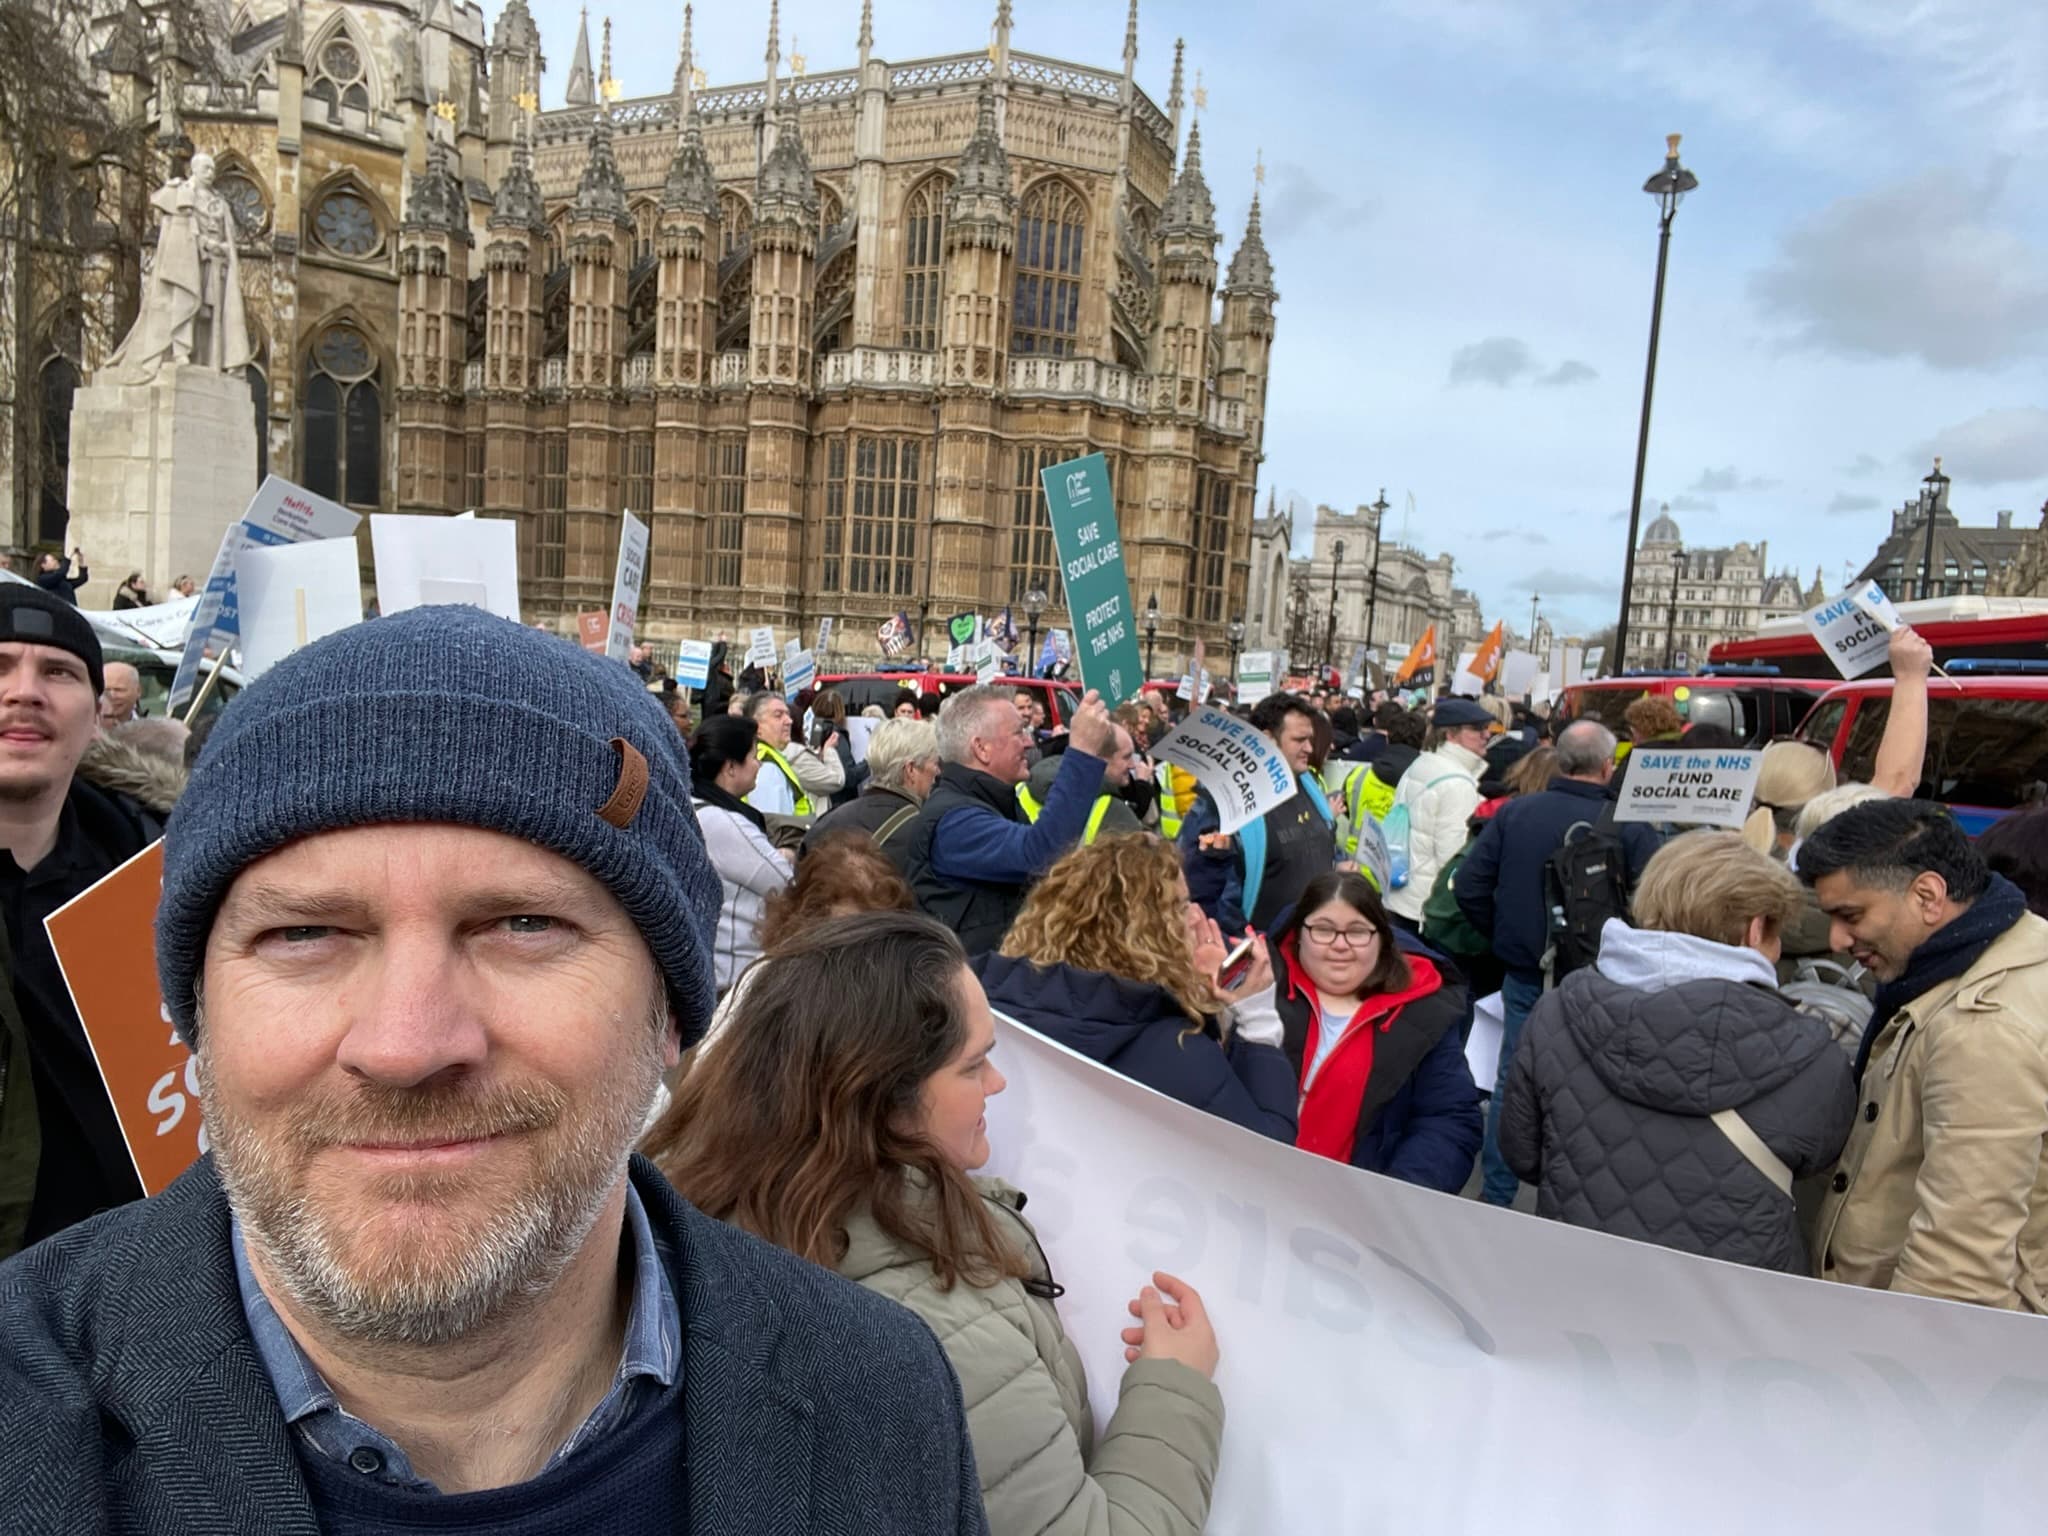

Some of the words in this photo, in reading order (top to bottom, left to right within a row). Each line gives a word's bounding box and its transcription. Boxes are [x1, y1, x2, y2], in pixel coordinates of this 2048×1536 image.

[1077, 521, 1100, 547] SAVE
[1067, 551, 1099, 582] SOCIAL
[1097, 541, 1119, 566] CARE
[1085, 595, 1121, 632] PROTECT
[1814, 597, 1855, 627] SAVE
[1090, 632, 1109, 657] THE
[1106, 621, 1125, 647] NHS
[1200, 711, 1245, 738] SAVE
[1241, 733, 1266, 758] the
[1263, 756, 1288, 795] NHS
[1215, 737, 1259, 775] FUND
[1640, 755, 1684, 770] SAVE
[1686, 755, 1711, 769] the
[1715, 756, 1753, 771] NHS
[1176, 734, 1233, 771] SOCIAL
[1232, 770, 1258, 815] CARE
[1667, 772, 1713, 785] FUND
[1632, 786, 1691, 799] SOCIAL
[1696, 787, 1744, 802] CARE
